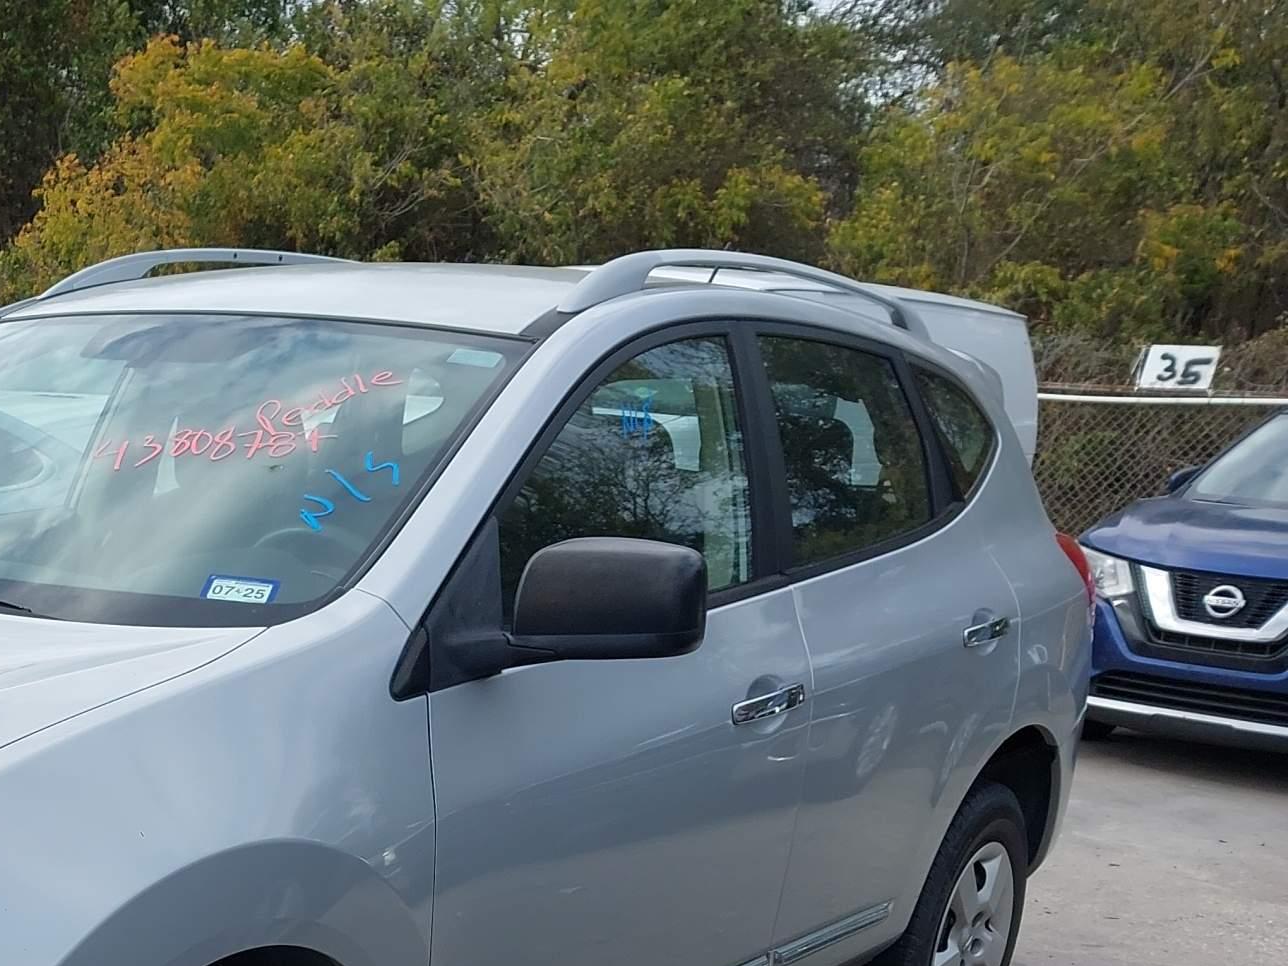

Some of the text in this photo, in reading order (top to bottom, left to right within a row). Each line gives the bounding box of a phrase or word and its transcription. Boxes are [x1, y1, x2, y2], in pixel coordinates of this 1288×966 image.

[1156, 352, 1215, 385] 35
[212, 584, 267, 599] 07 25
